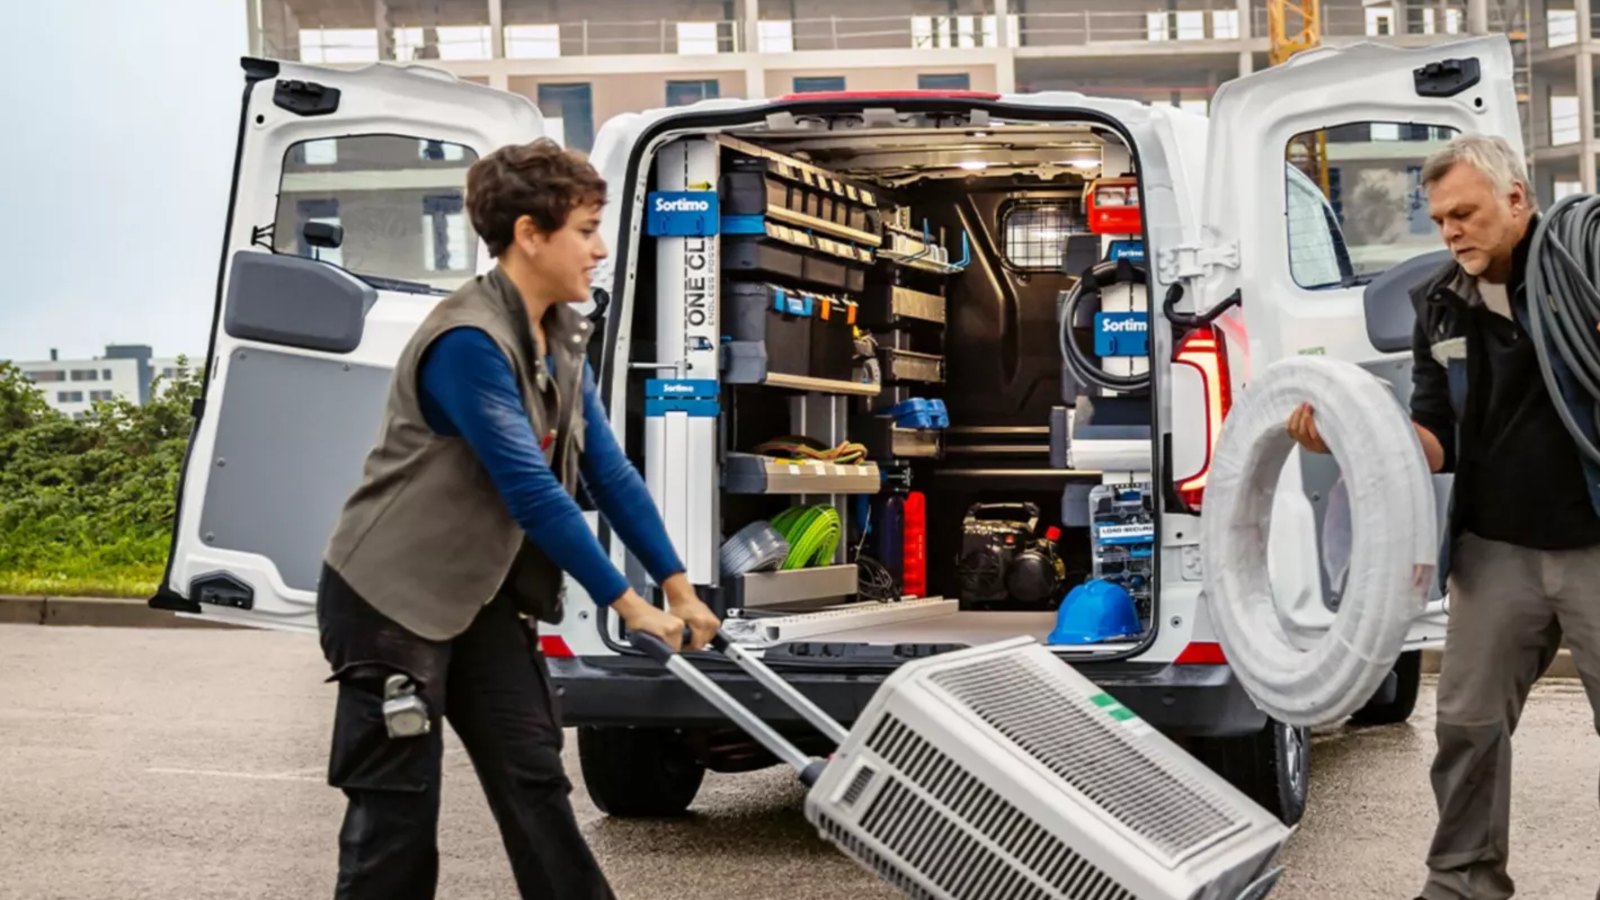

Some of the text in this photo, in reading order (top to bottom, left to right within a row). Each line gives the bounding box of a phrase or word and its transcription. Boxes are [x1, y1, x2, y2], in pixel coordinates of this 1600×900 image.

[655, 197, 709, 212] Sortimo
[688, 237, 705, 326] ONE CL
[1102, 318, 1148, 332] Sortim
[663, 384, 694, 392] Sortimo
